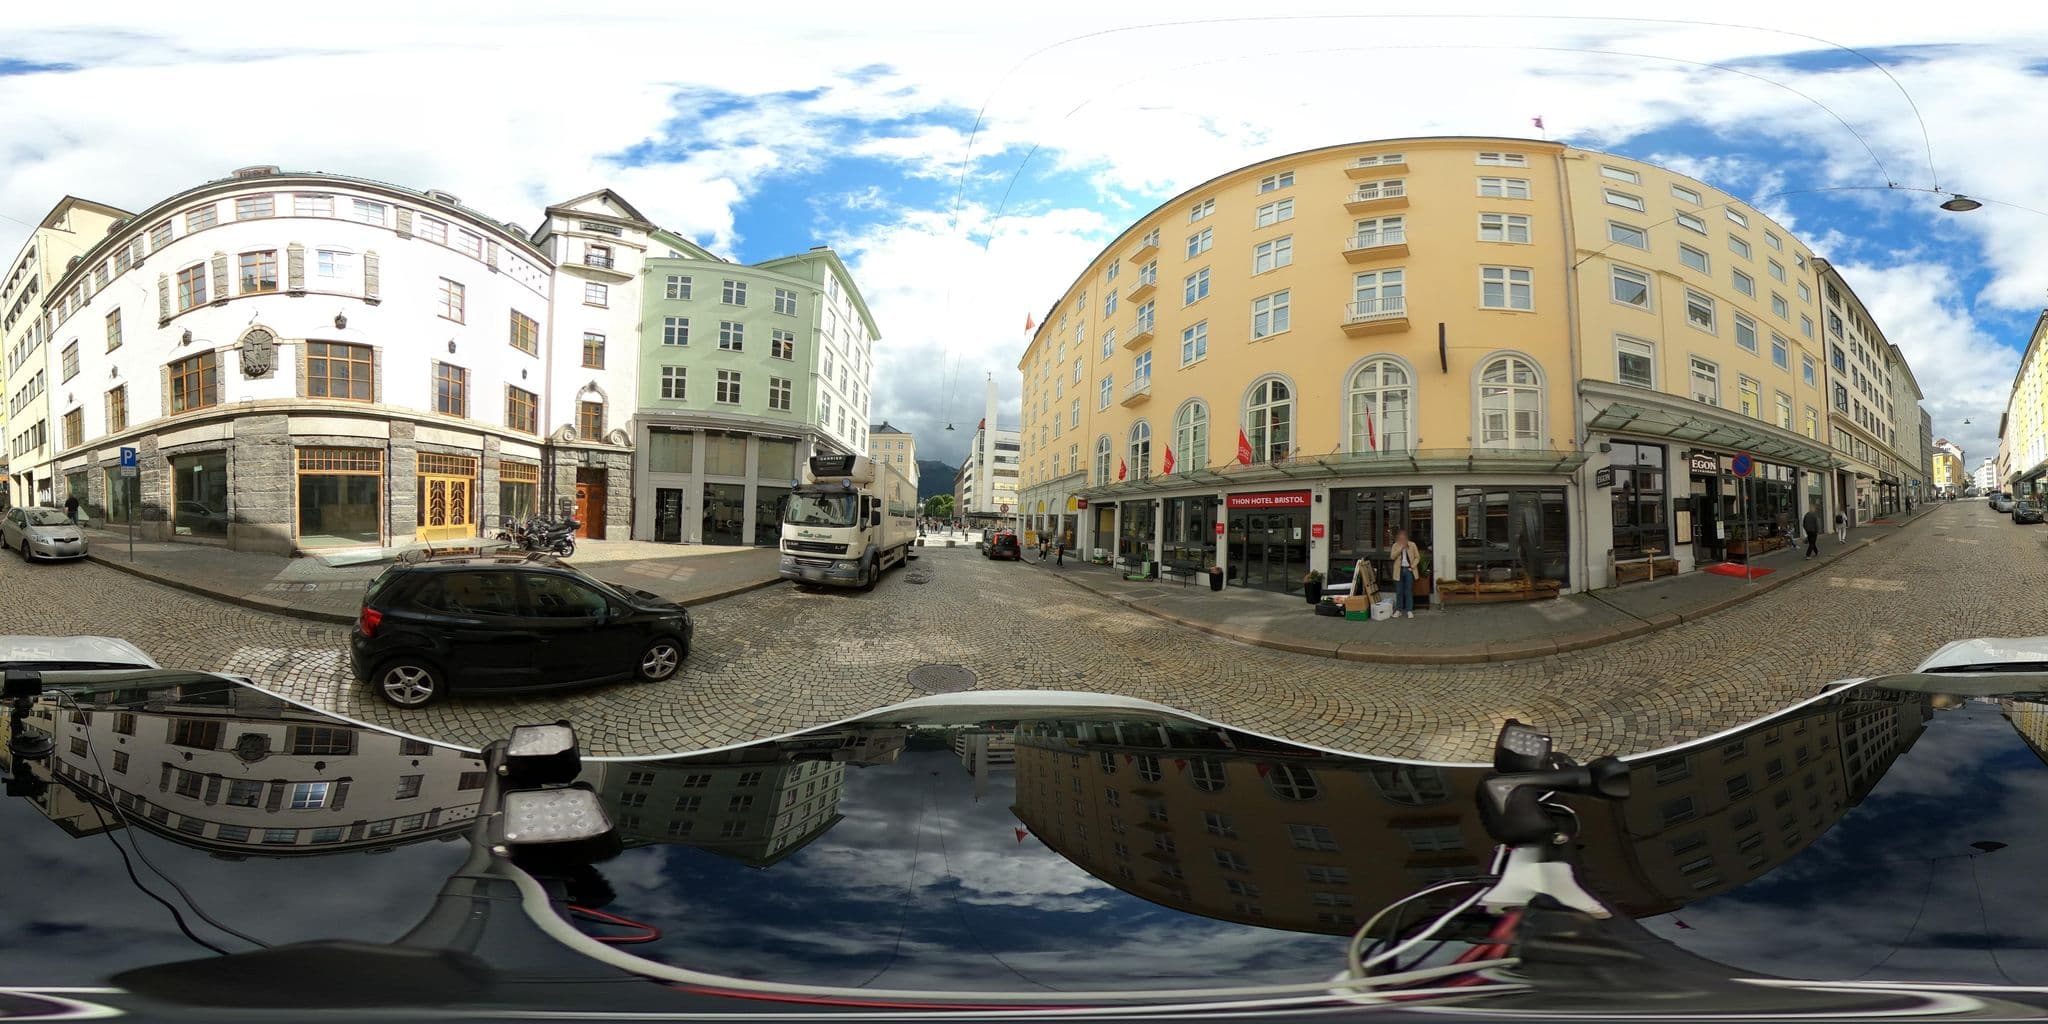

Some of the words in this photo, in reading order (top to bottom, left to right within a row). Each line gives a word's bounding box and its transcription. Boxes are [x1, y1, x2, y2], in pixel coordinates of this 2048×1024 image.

[124, 449, 133, 464] P
[1692, 459, 1717, 470] EGON
[1274, 496, 1305, 504] BRISTOL
